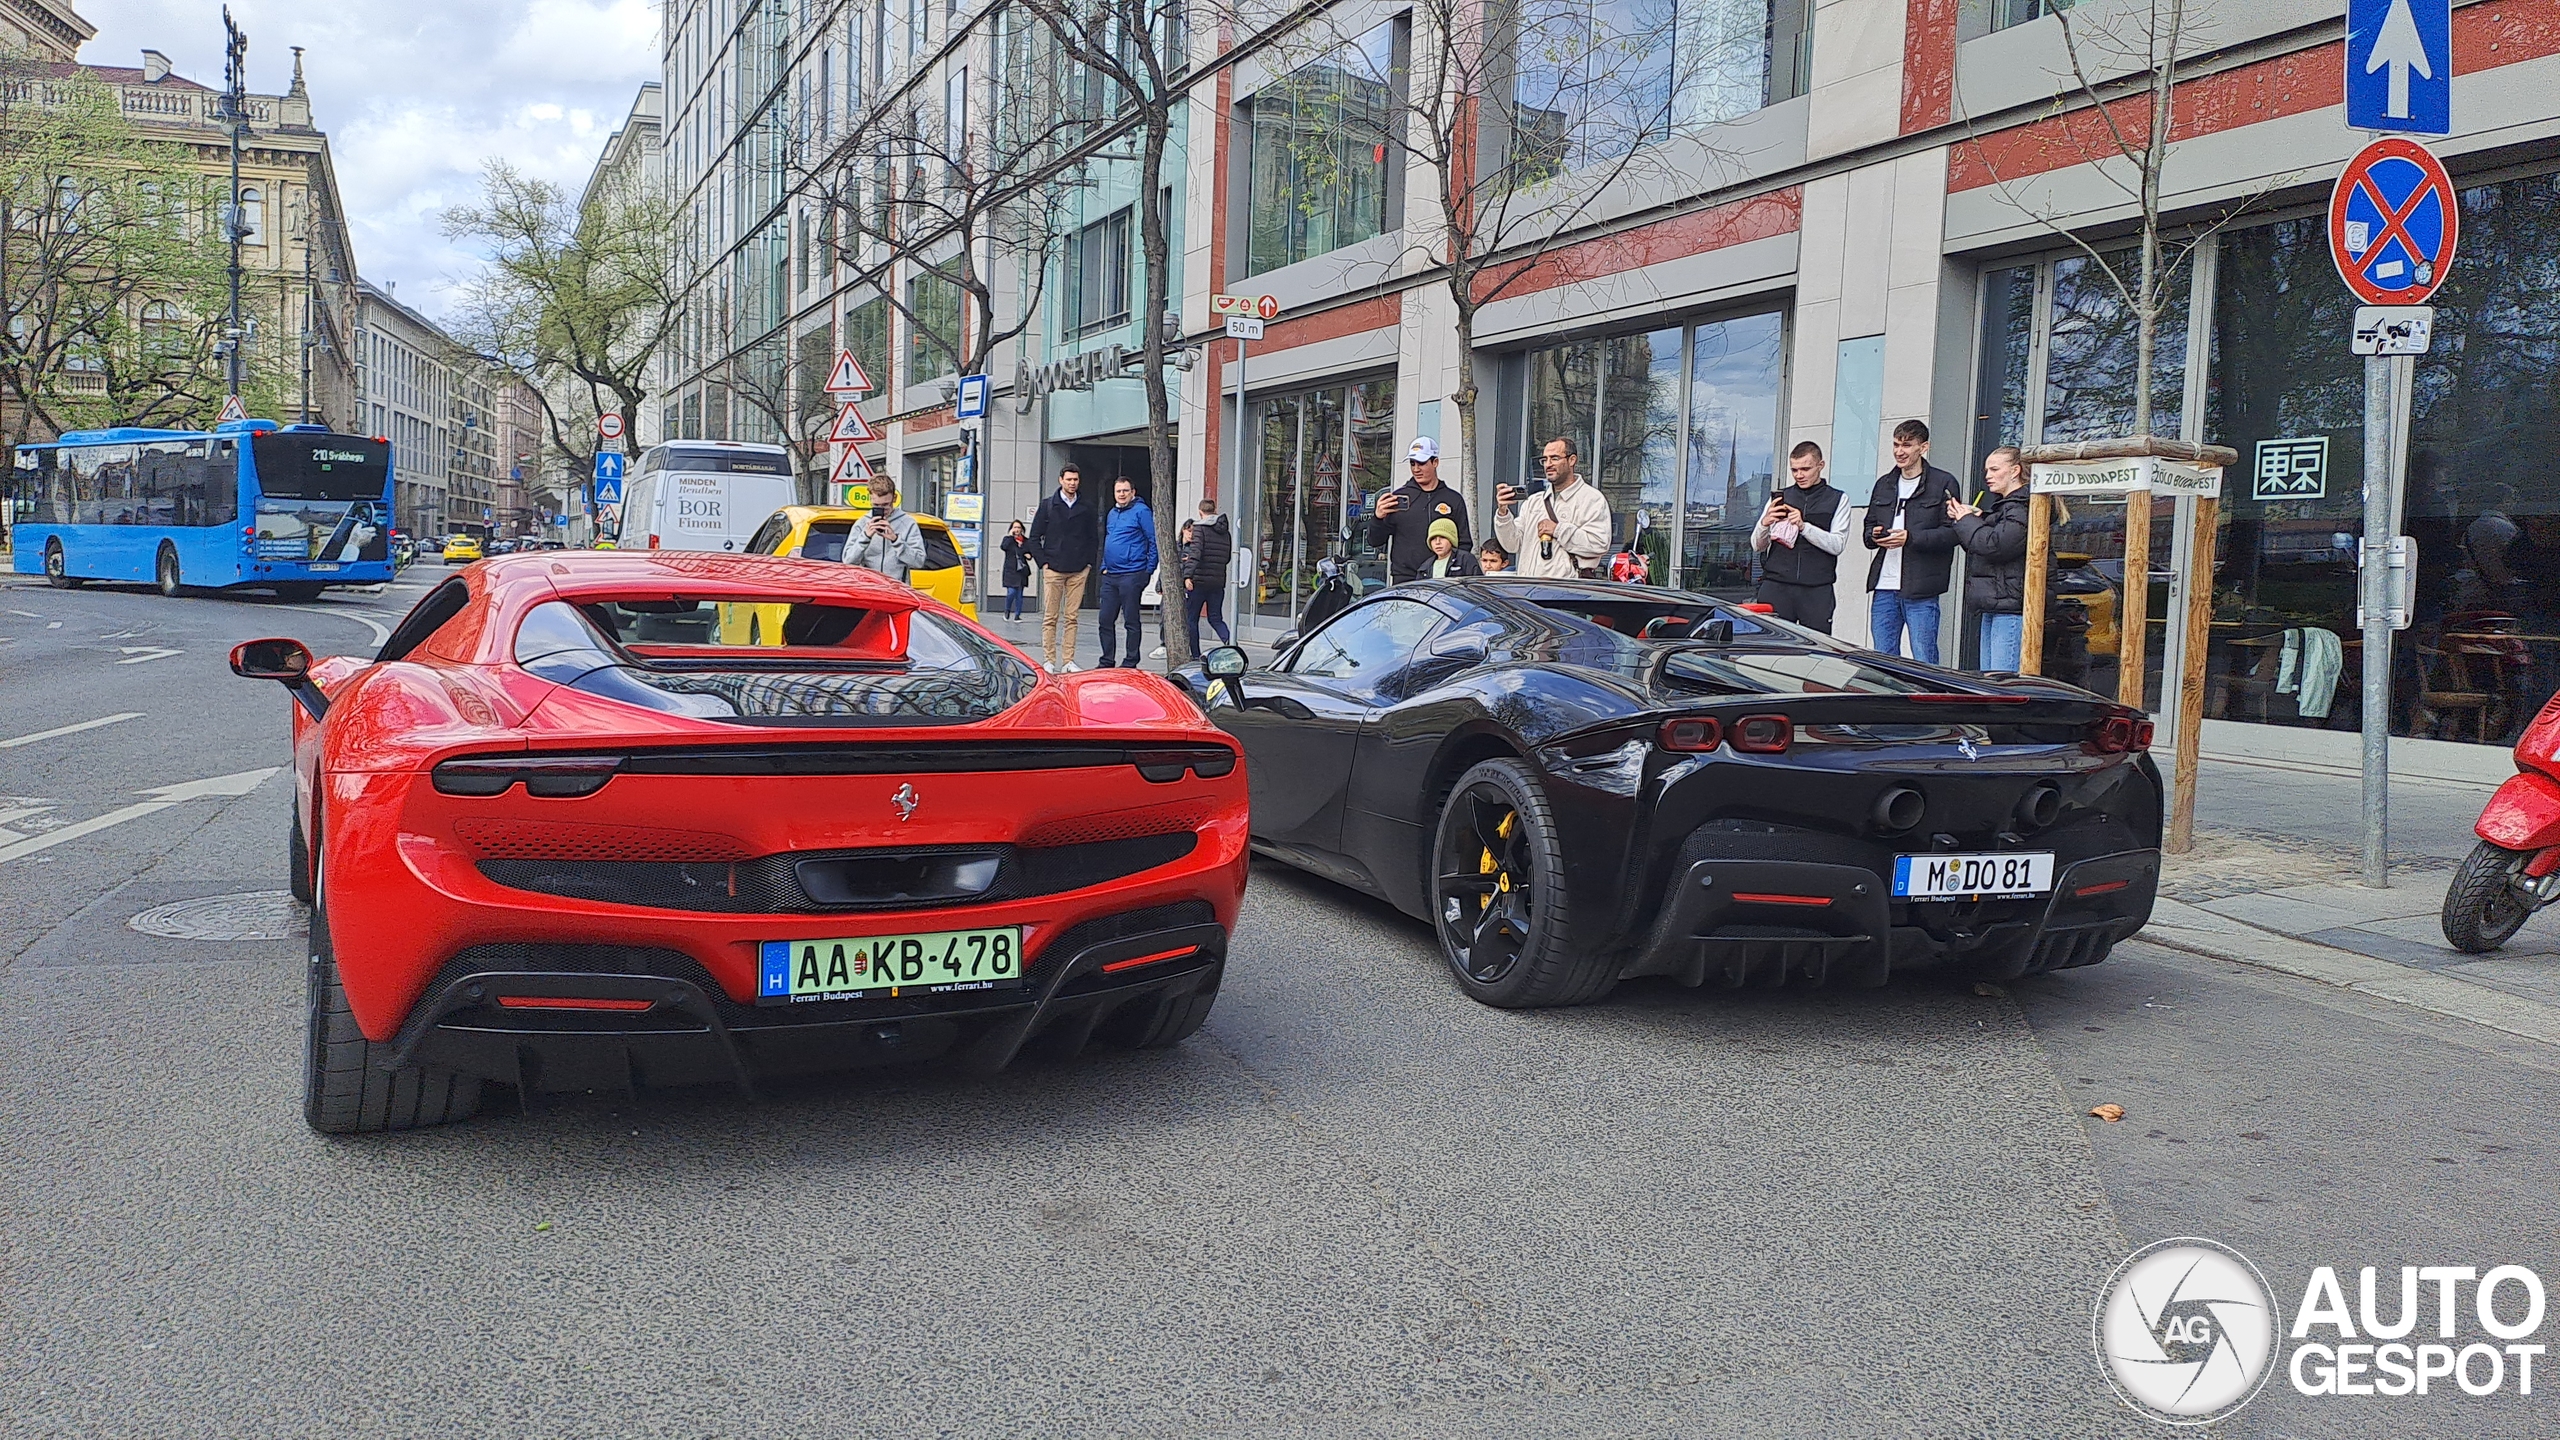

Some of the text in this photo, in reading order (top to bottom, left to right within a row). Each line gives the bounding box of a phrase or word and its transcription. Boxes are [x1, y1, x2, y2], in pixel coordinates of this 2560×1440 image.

[1232, 321, 1259, 334] 50 m
[312, 448, 328, 461] 210
[2260, 445, 2321, 492] 東京
[679, 477, 717, 487] MINDEN
[2045, 469, 2076, 486] ZÖLD
[2077, 467, 2140, 485] BUDAPEST
[678, 486, 722, 495] Rendben
[678, 500, 723, 517] BOR
[678, 517, 722, 529] Finom
[1927, 858, 2032, 892] M DO 81
[1897, 881, 1905, 891] D
[1910, 894, 1956, 903] Ferrari Budapest
[797, 934, 1011, 989] AA KB-478
[768, 973, 783, 989] H
[930, 980, 994, 992] www.ferrari.hu
[790, 989, 864, 1003] Ferrari Budapest
